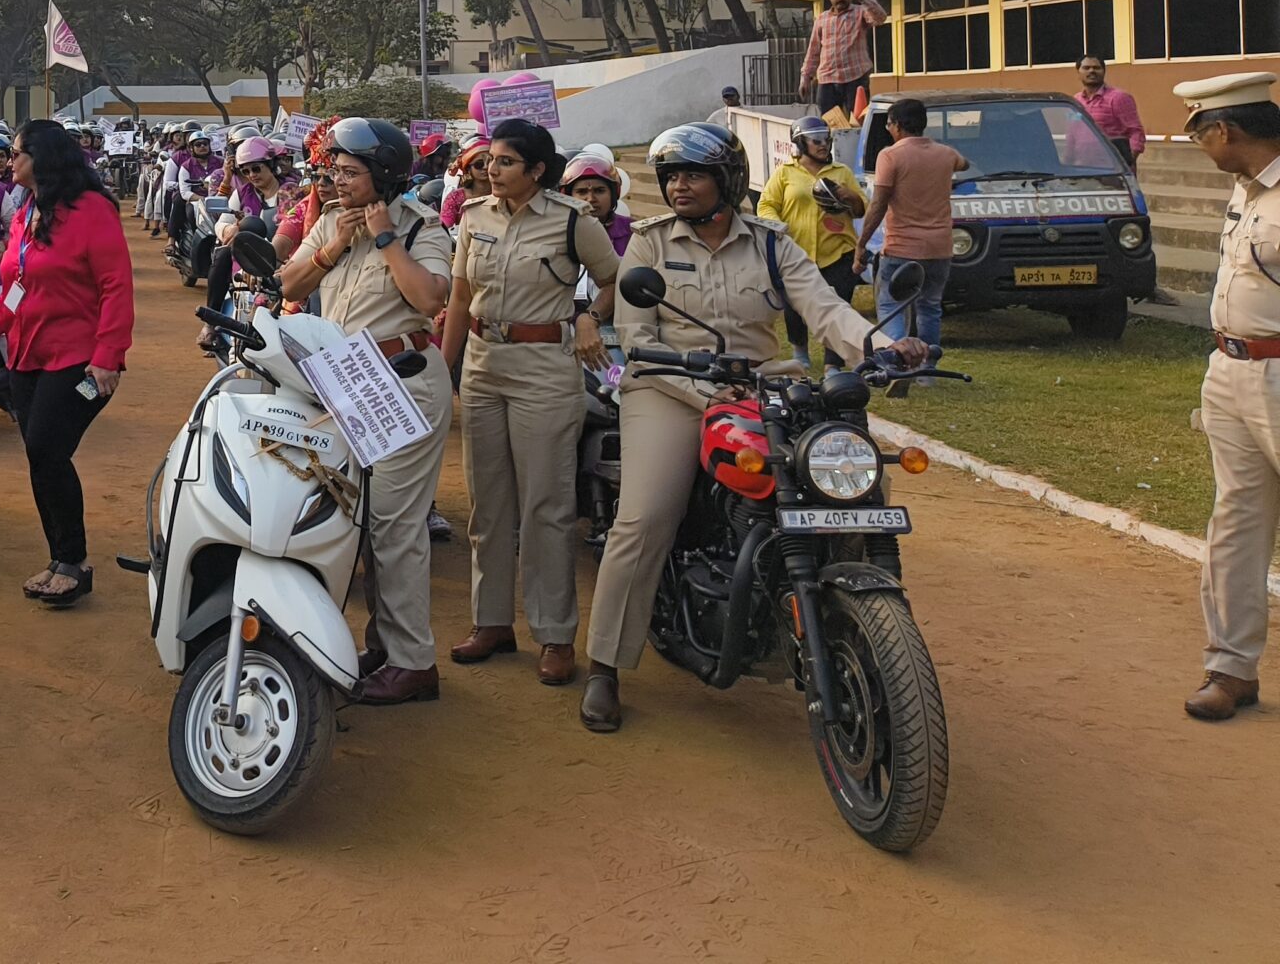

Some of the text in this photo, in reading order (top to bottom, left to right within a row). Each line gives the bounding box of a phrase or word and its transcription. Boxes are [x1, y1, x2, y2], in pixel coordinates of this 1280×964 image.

[954, 196, 1132, 216] TRAFFIC POLICE
[1020, 269, 1093, 283] AP31 TA 5273
[339, 353, 367, 386] THE
[359, 383, 398, 437] WHEEL
[349, 341, 360, 350] A
[355, 349, 389, 393] WOMAN
[384, 392, 416, 436] BEHIND
[322, 351, 332, 361] IS
[327, 359, 335, 369] A
[332, 365, 348, 387] FORCE
[342, 383, 353, 394] TO
[348, 390, 358, 402] BE
[354, 399, 379, 434] RECKONED
[375, 433, 391, 452] WITH.
[268, 407, 308, 422] HONDA
[241, 419, 330, 449] AP 39 GV 68
[800, 512, 903, 526] AP 40FV 4459
